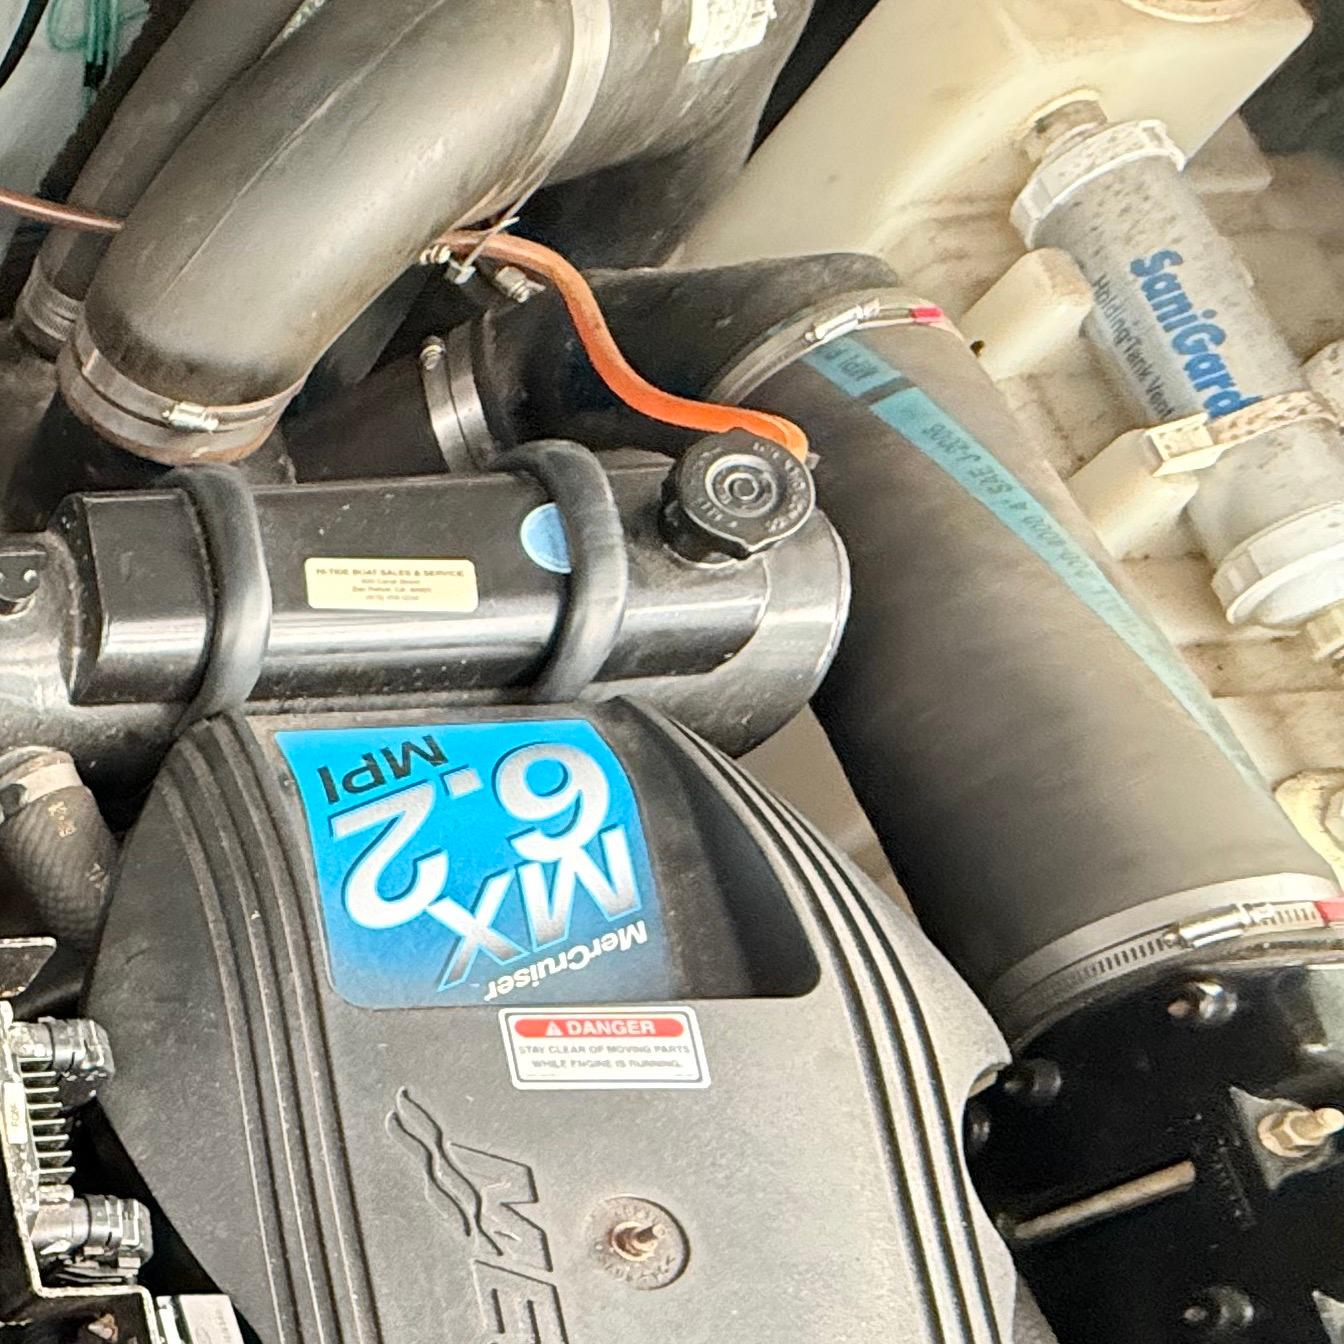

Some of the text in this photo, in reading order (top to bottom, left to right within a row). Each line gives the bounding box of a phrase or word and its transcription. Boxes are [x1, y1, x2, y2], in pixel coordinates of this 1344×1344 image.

[1123, 336, 1153, 382] Tank
[1130, 250, 1263, 419] SaniGard
[317, 735, 449, 805] MPI
[328, 741, 609, 930] 6.2
[397, 824, 642, 993] MX
[483, 919, 648, 1002] MerCruiser
[518, 1045, 690, 1054] STAY CLEAR OF MOVING PARTS
[566, 1020, 656, 1036] DANGER
[531, 1059, 567, 1068] WHILE
[570, 1059, 612, 1068] ENGINE
[615, 1059, 627, 1068] IS
